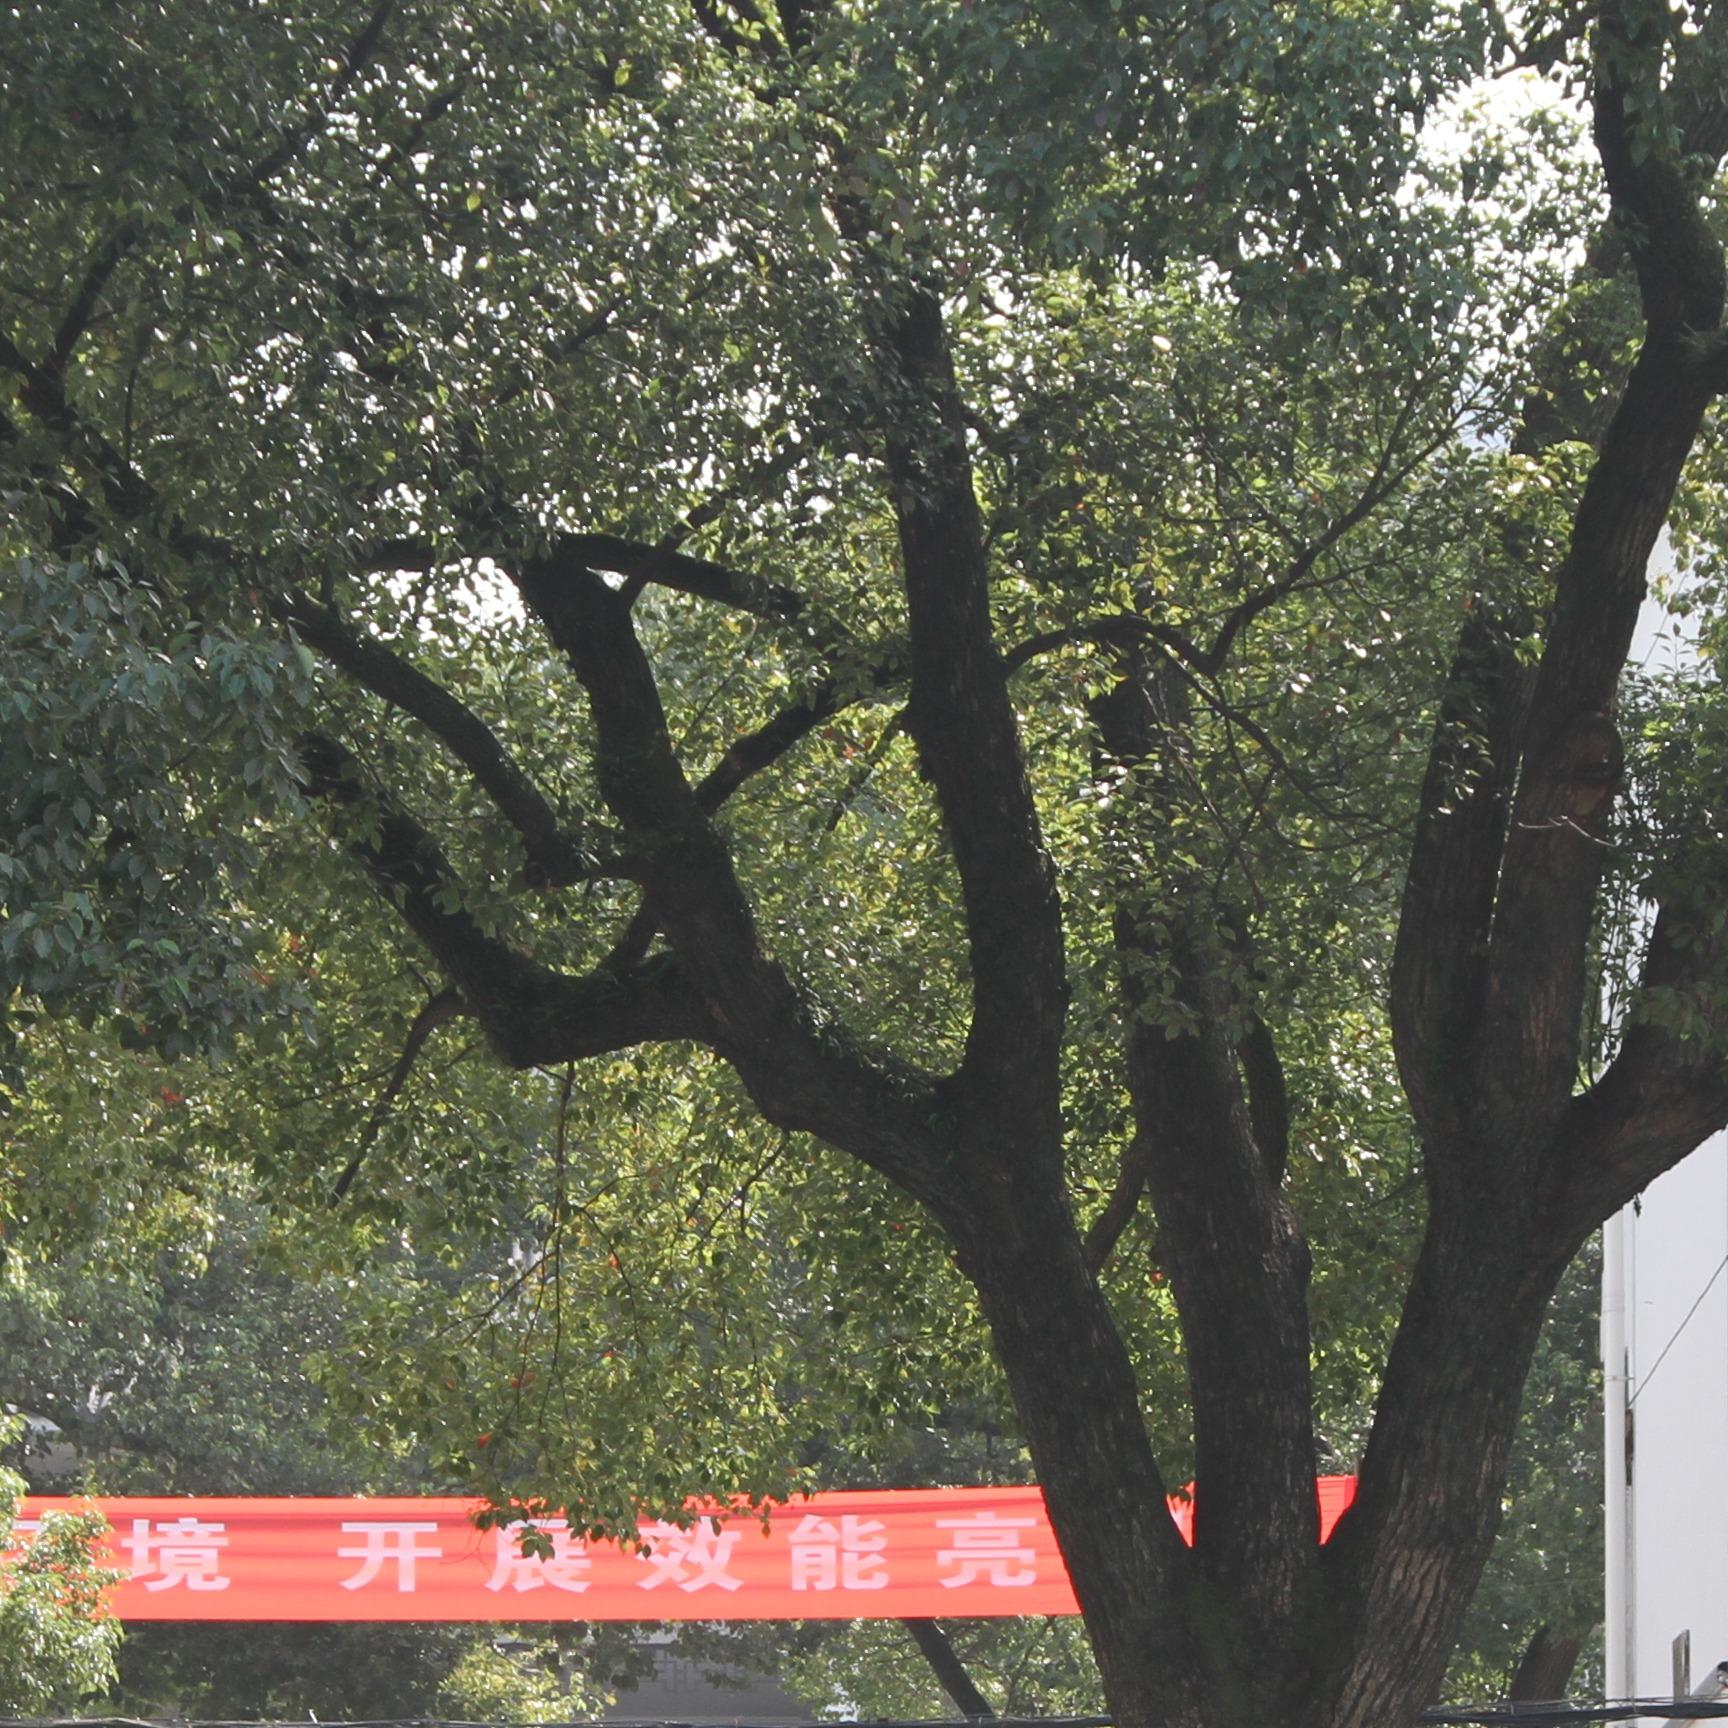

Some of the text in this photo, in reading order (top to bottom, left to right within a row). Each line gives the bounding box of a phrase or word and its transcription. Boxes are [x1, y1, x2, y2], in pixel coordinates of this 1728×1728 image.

[337, 1510, 1184, 1594] 开展效能亮
